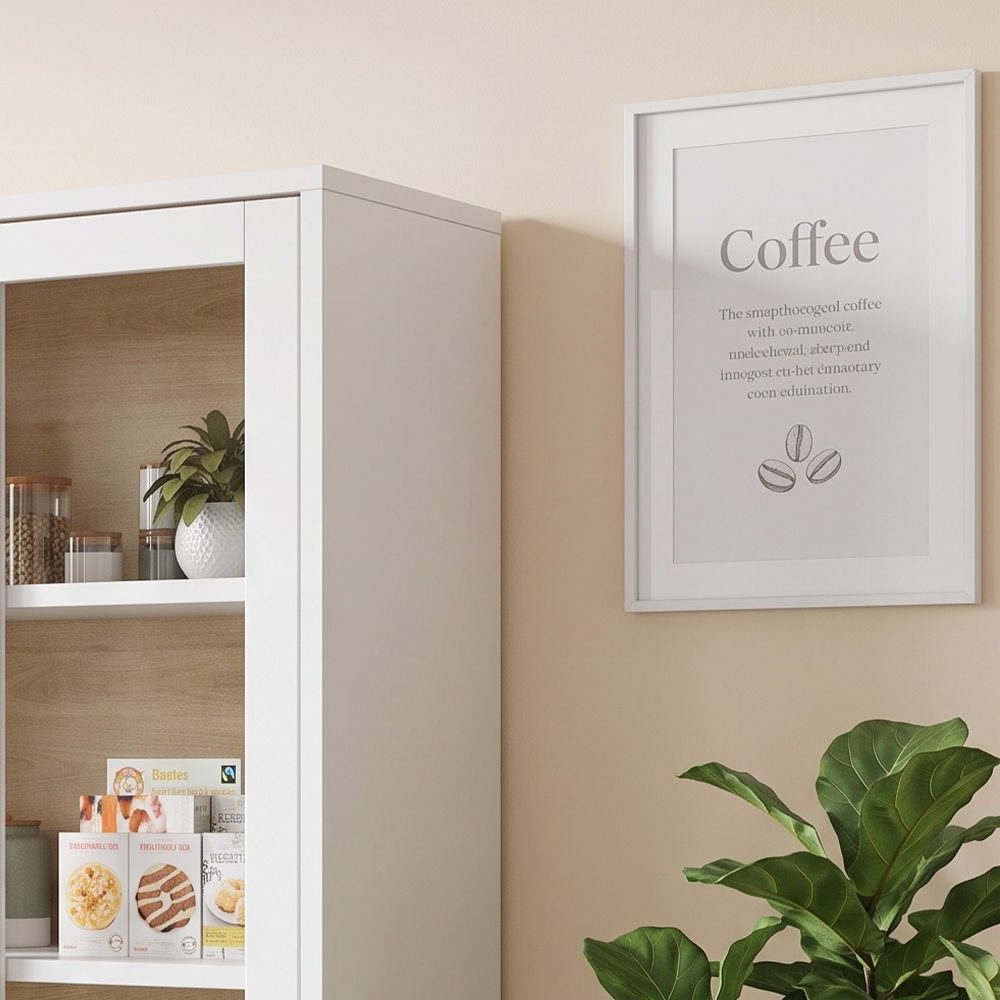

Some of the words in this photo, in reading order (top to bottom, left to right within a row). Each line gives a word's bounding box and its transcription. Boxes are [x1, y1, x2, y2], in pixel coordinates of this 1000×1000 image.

[720, 219, 880, 273] Coffee
[718, 308, 743, 321] The
[843, 298, 883, 312] coffee
[747, 325, 775, 338] with
[720, 369, 774, 383] innogost
[780, 382, 852, 398] eduination.
